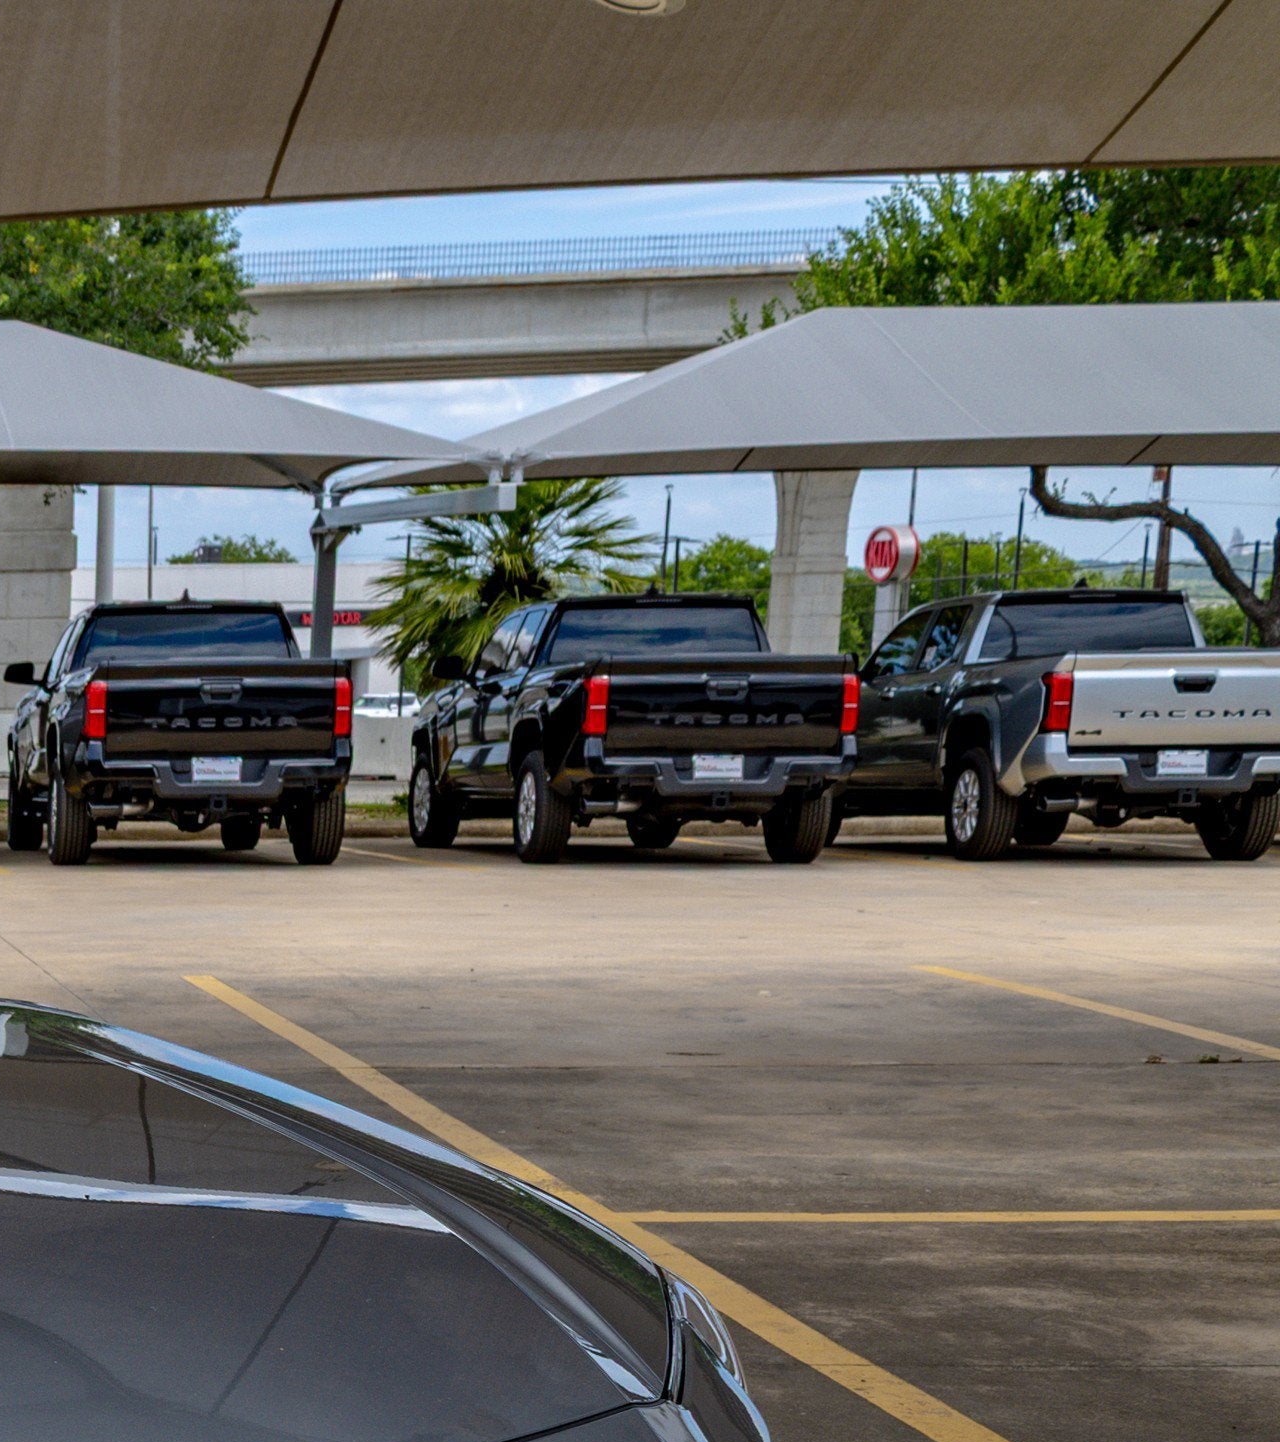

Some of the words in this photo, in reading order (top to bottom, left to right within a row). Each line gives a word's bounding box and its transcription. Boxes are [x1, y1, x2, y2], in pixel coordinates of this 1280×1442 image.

[647, 713, 804, 725] TACOMA
[1112, 709, 1271, 719] TACOMA
[144, 717, 297, 728] TACOMA
